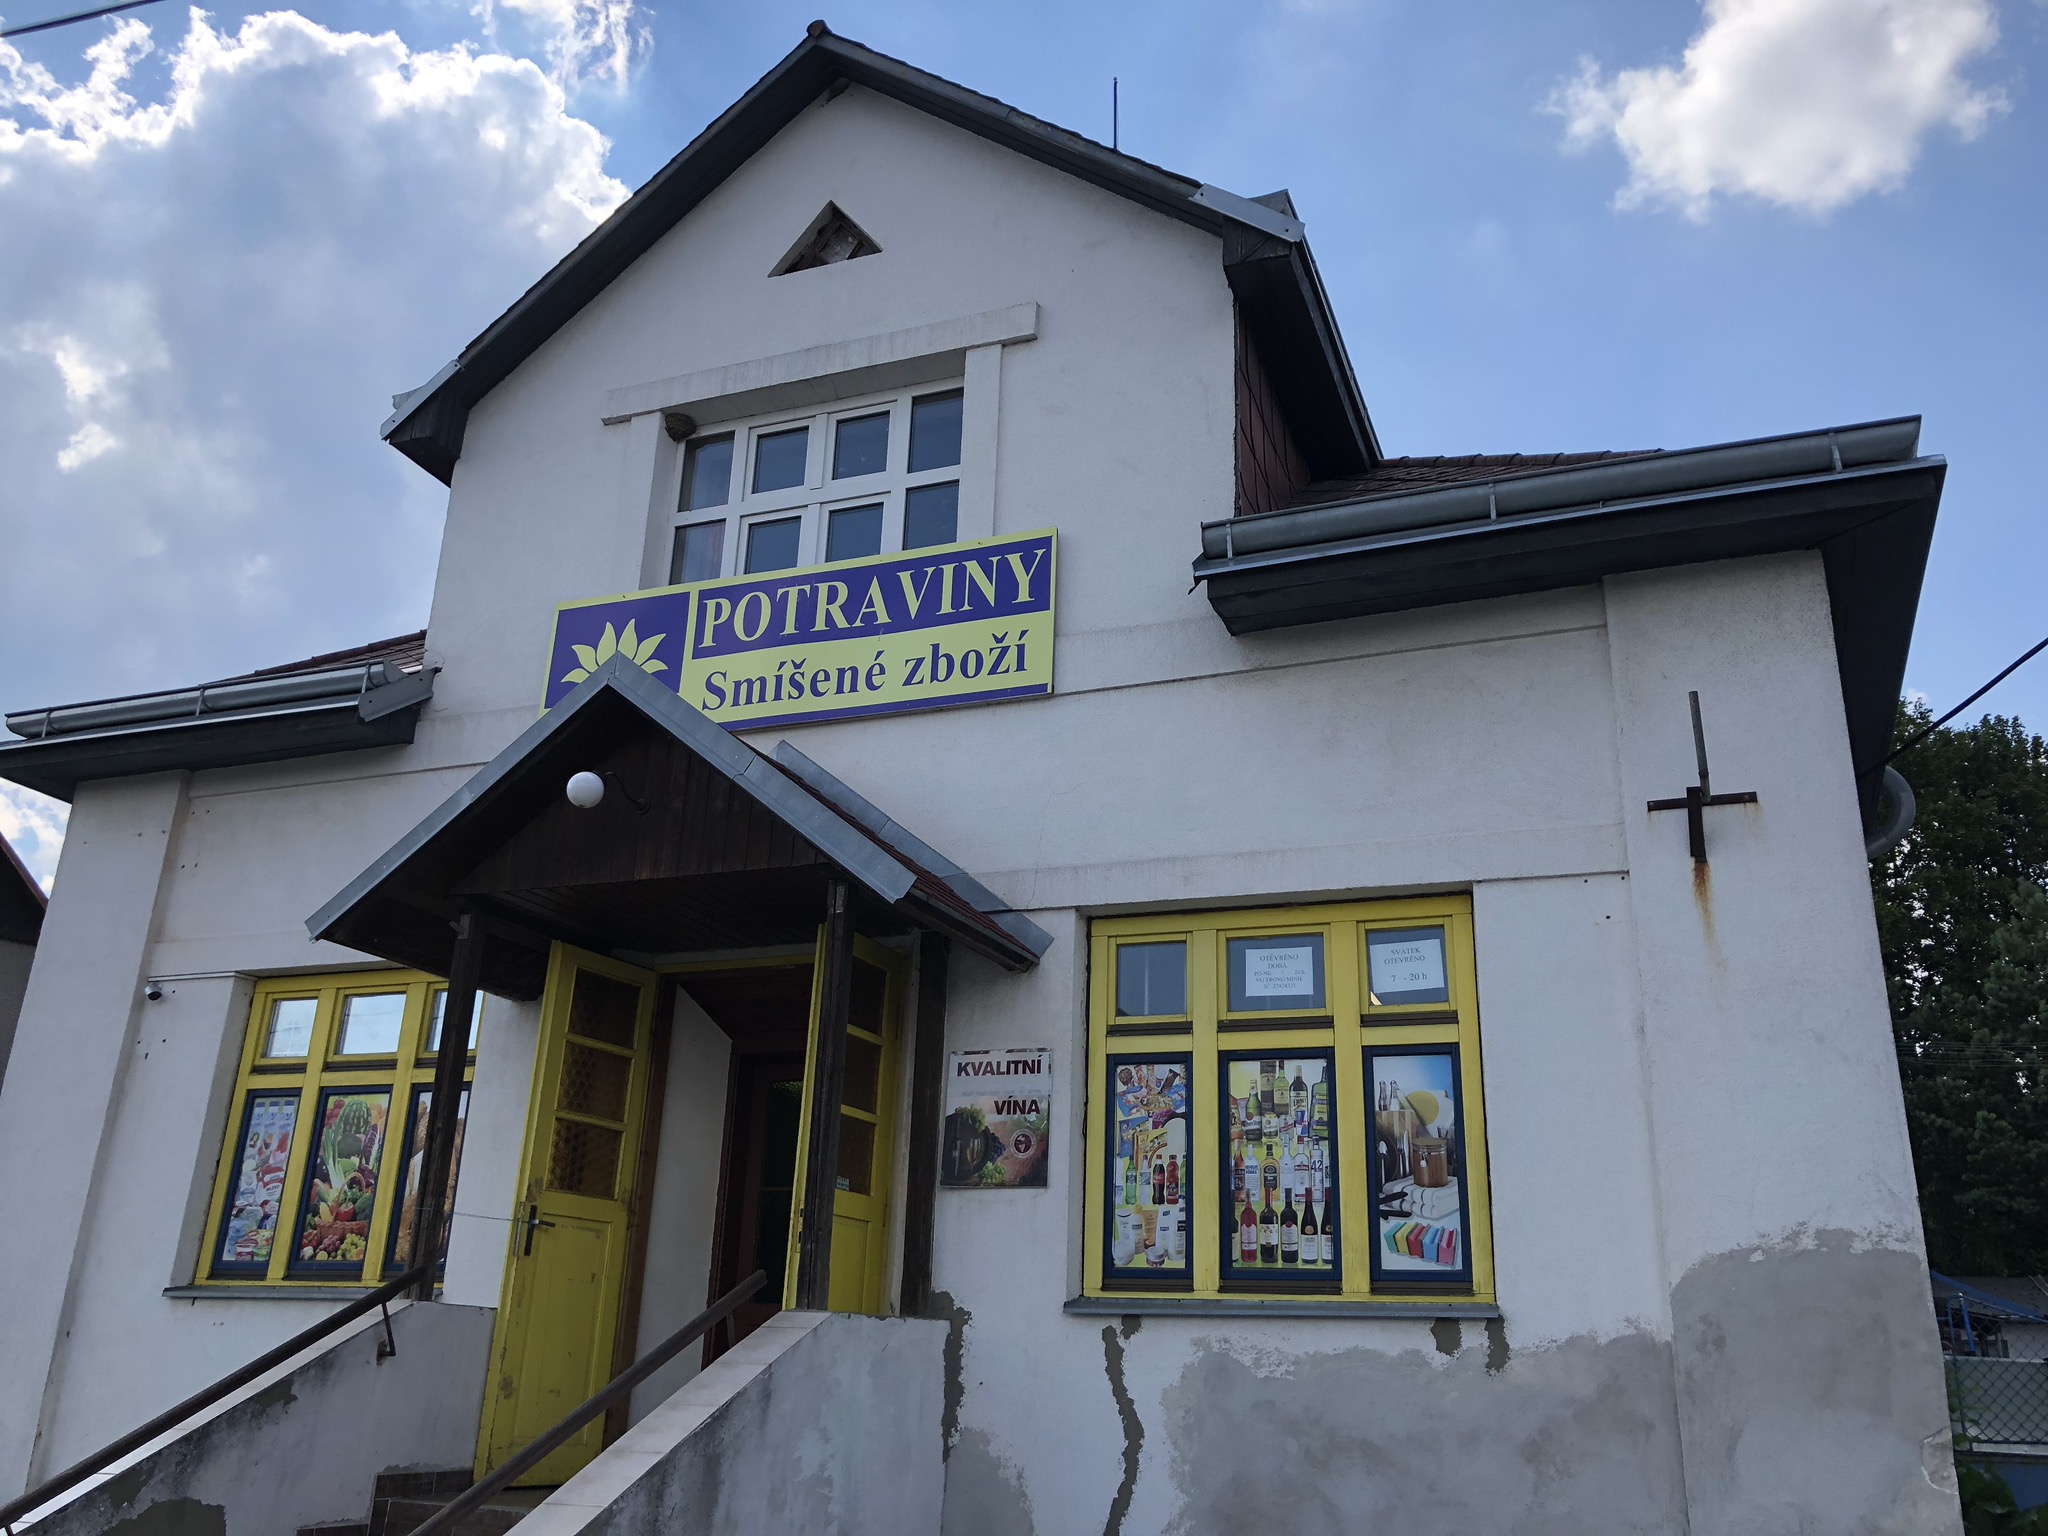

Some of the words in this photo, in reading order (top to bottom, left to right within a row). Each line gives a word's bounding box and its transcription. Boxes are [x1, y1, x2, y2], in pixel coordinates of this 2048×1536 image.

[698, 548, 1046, 649] POTRAVINY
[701, 650, 886, 711] Smíšené
[903, 629, 1030, 687] zboží
[1409, 973, 1420, 981] 20
[1422, 972, 1427, 980] h
[957, 1054, 1042, 1077] KVALITNÍ
[994, 1095, 1041, 1115] VÍNA
